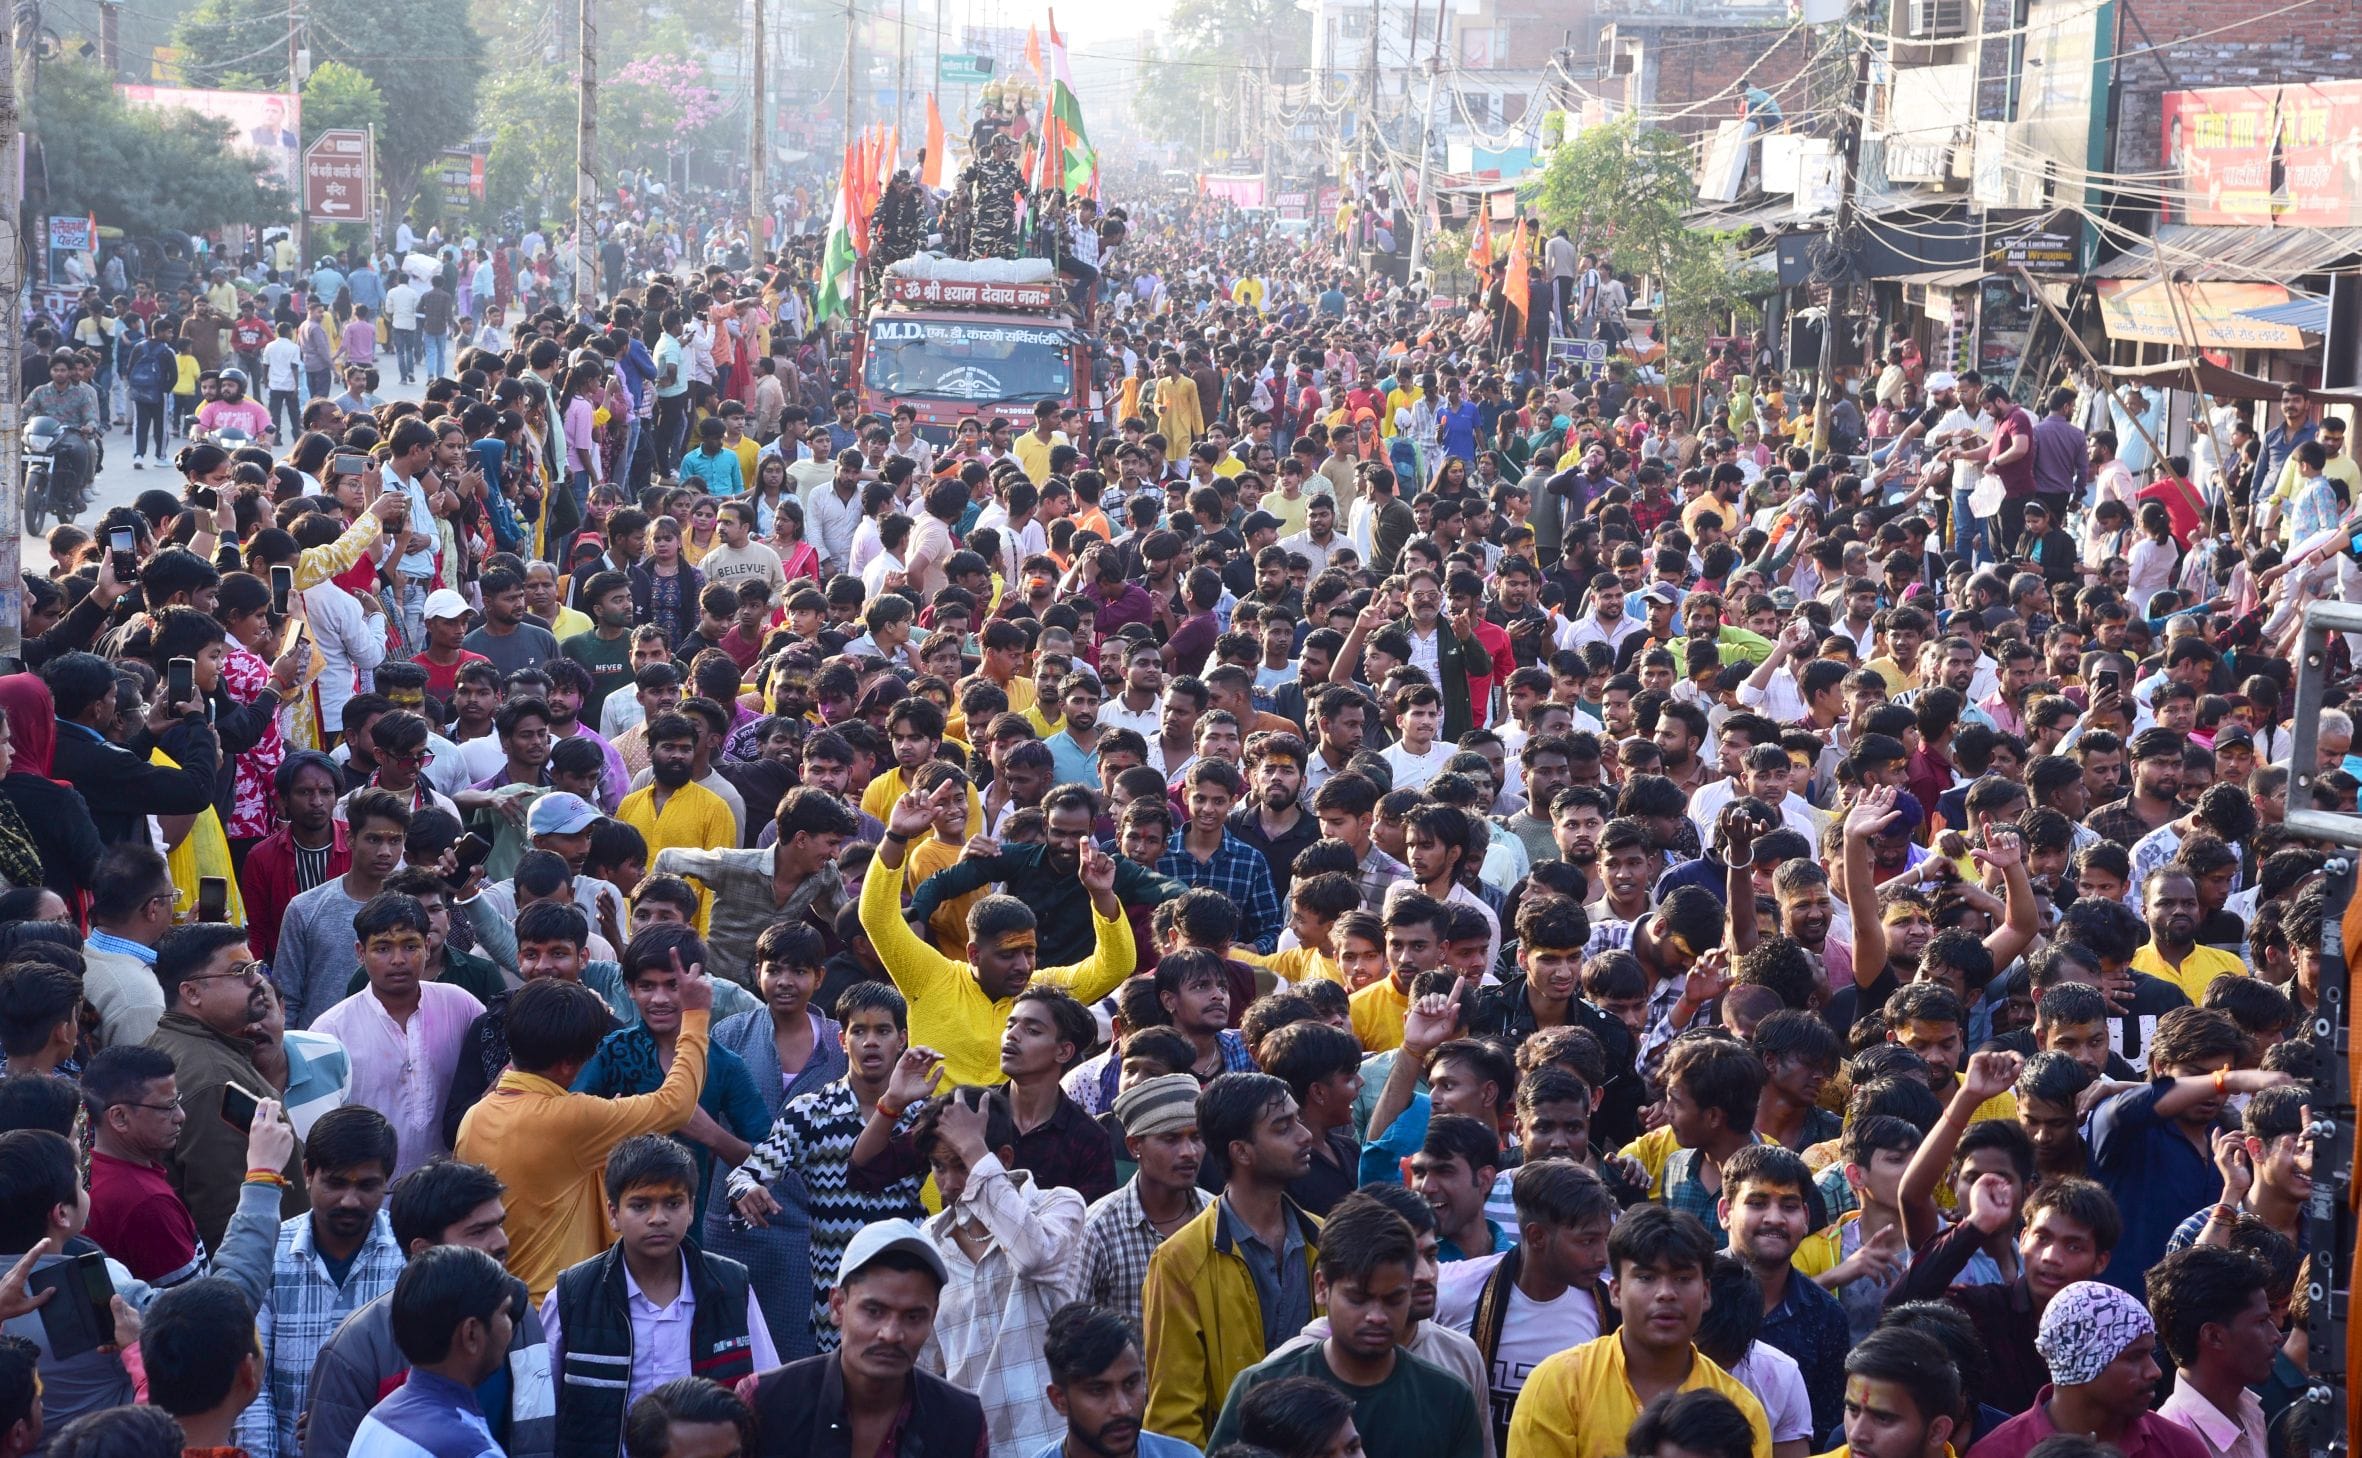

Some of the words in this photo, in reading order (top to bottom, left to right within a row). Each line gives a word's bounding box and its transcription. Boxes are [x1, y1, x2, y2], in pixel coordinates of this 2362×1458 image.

[1275, 193, 1306, 206] HOTEL
[2008, 250, 2026, 259] And
[924, 280, 941, 301] श्री
[943, 286, 976, 301] श्याम
[981, 284, 1014, 303] देवाय
[875, 322, 926, 340] M.D.
[717, 563, 767, 578] BELLEVUE
[595, 663, 623, 672] NEVER
